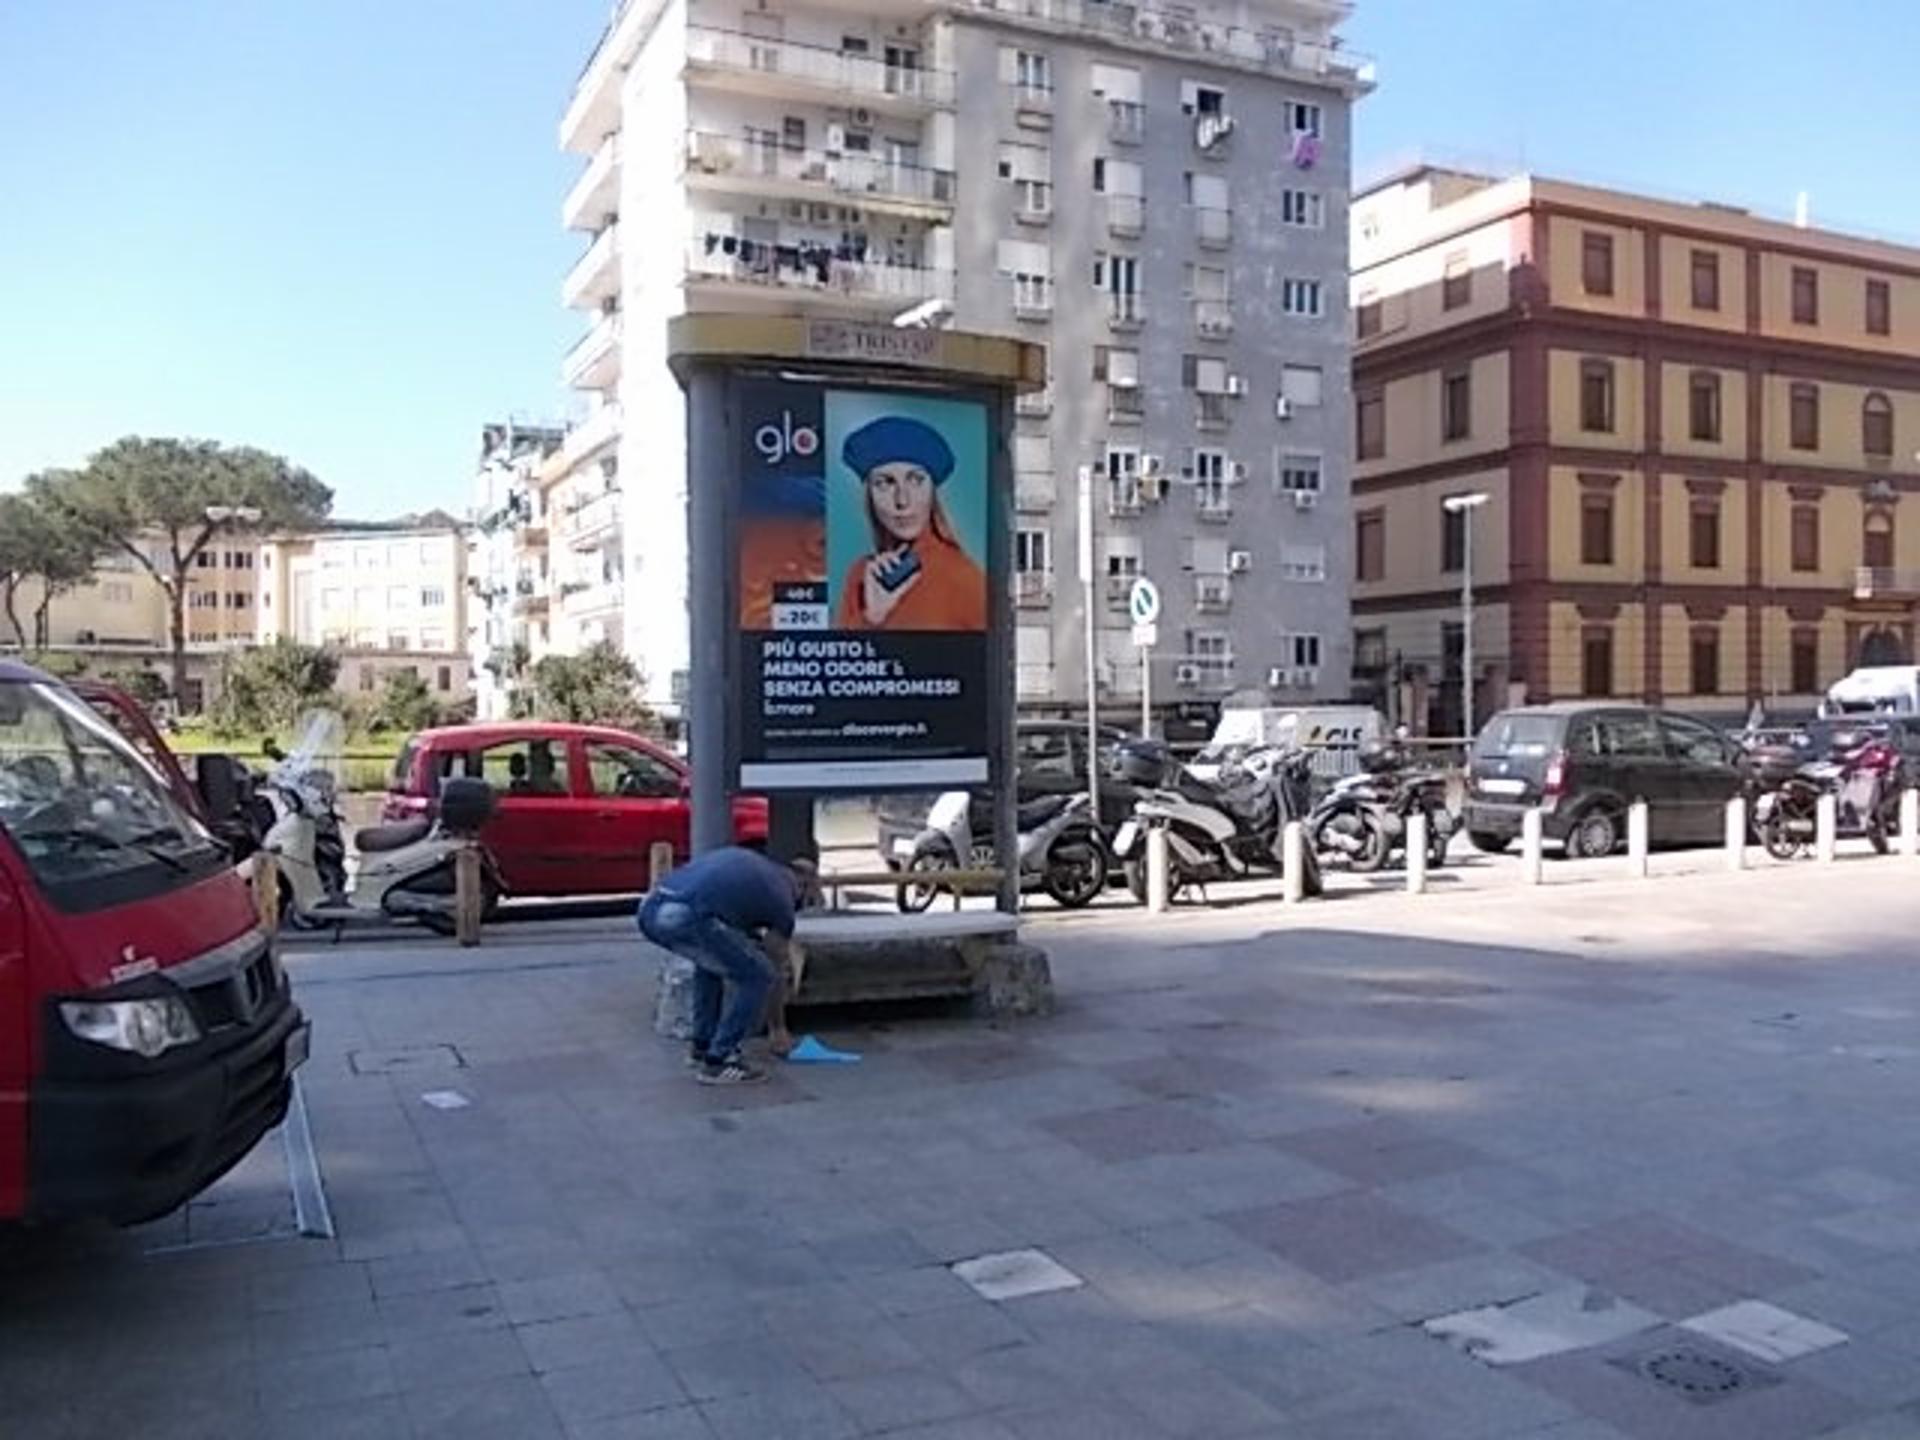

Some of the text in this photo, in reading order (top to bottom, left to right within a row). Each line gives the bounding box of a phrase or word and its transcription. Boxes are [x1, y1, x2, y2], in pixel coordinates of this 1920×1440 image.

[755, 409, 818, 463] glo
[763, 637, 795, 657] PIÙ
[798, 640, 862, 658] GUSTO
[763, 660, 821, 676] MENO
[763, 679, 961, 696] SENZA COMPROMESSI
